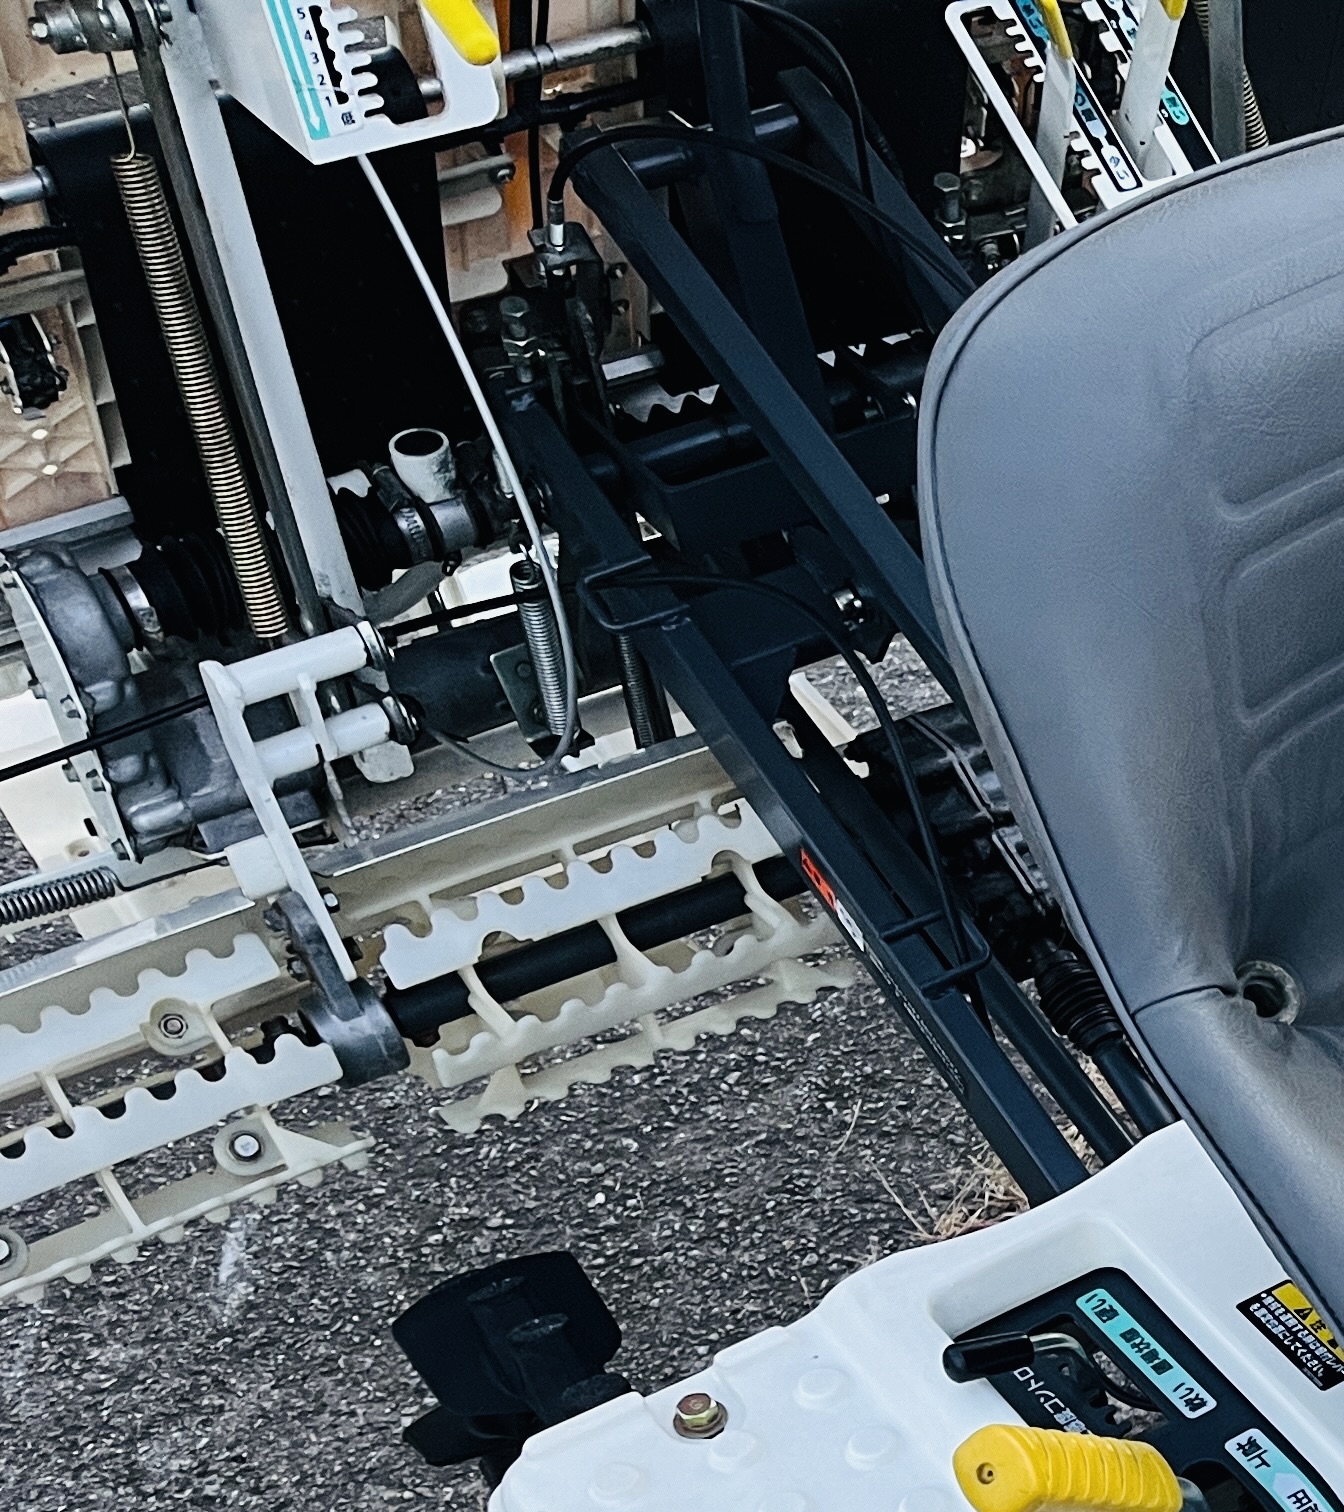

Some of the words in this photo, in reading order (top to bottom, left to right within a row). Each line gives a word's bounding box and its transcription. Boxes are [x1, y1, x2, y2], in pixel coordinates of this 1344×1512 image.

[297, 7, 306, 20] 5
[304, 29, 312, 42] 4
[311, 52, 319, 65] 3
[317, 74, 326, 86] 2
[325, 95, 332, 108] 1
[1013, 1367, 1088, 1434] 感度コントロ
[1235, 1434, 1273, 1470] 上昇
